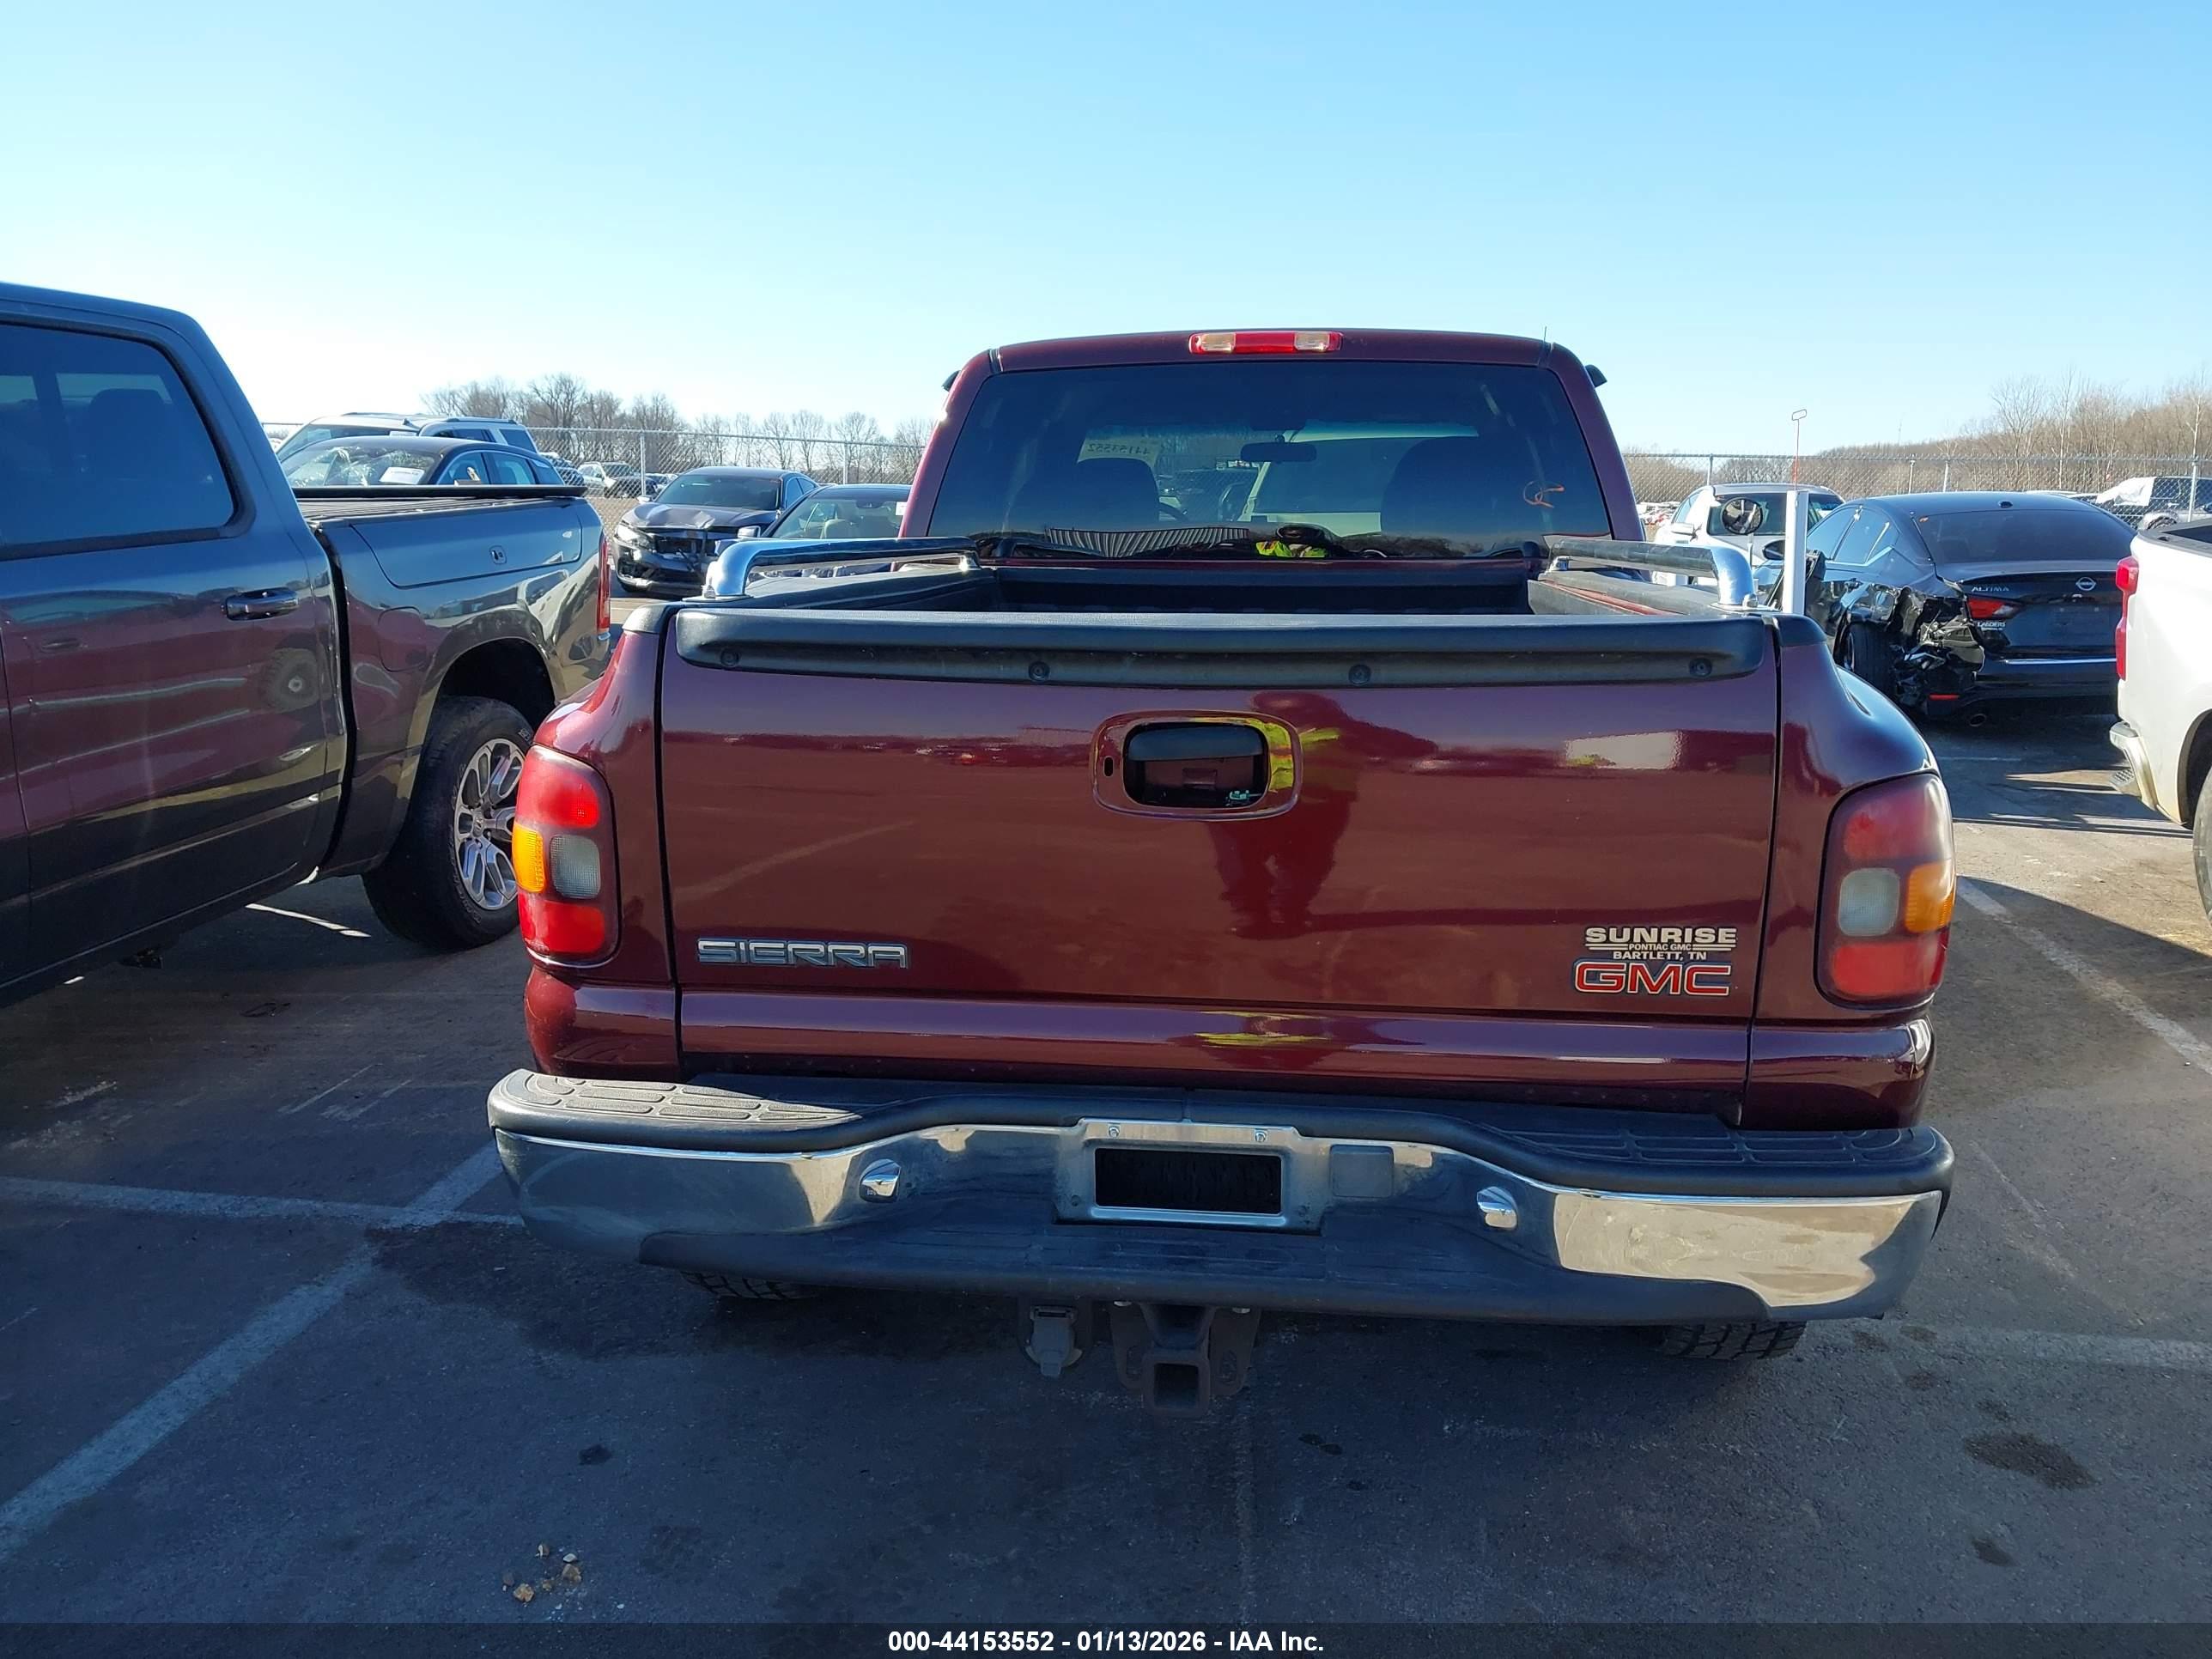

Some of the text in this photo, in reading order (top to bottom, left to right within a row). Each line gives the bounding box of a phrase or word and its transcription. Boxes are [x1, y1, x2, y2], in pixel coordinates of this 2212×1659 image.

[1585, 927, 1736, 944] SUNRISE
[697, 939, 908, 969] SIERRA
[1613, 951, 1707, 961] BARTLETT, TN
[1574, 961, 1731, 996] GMC
